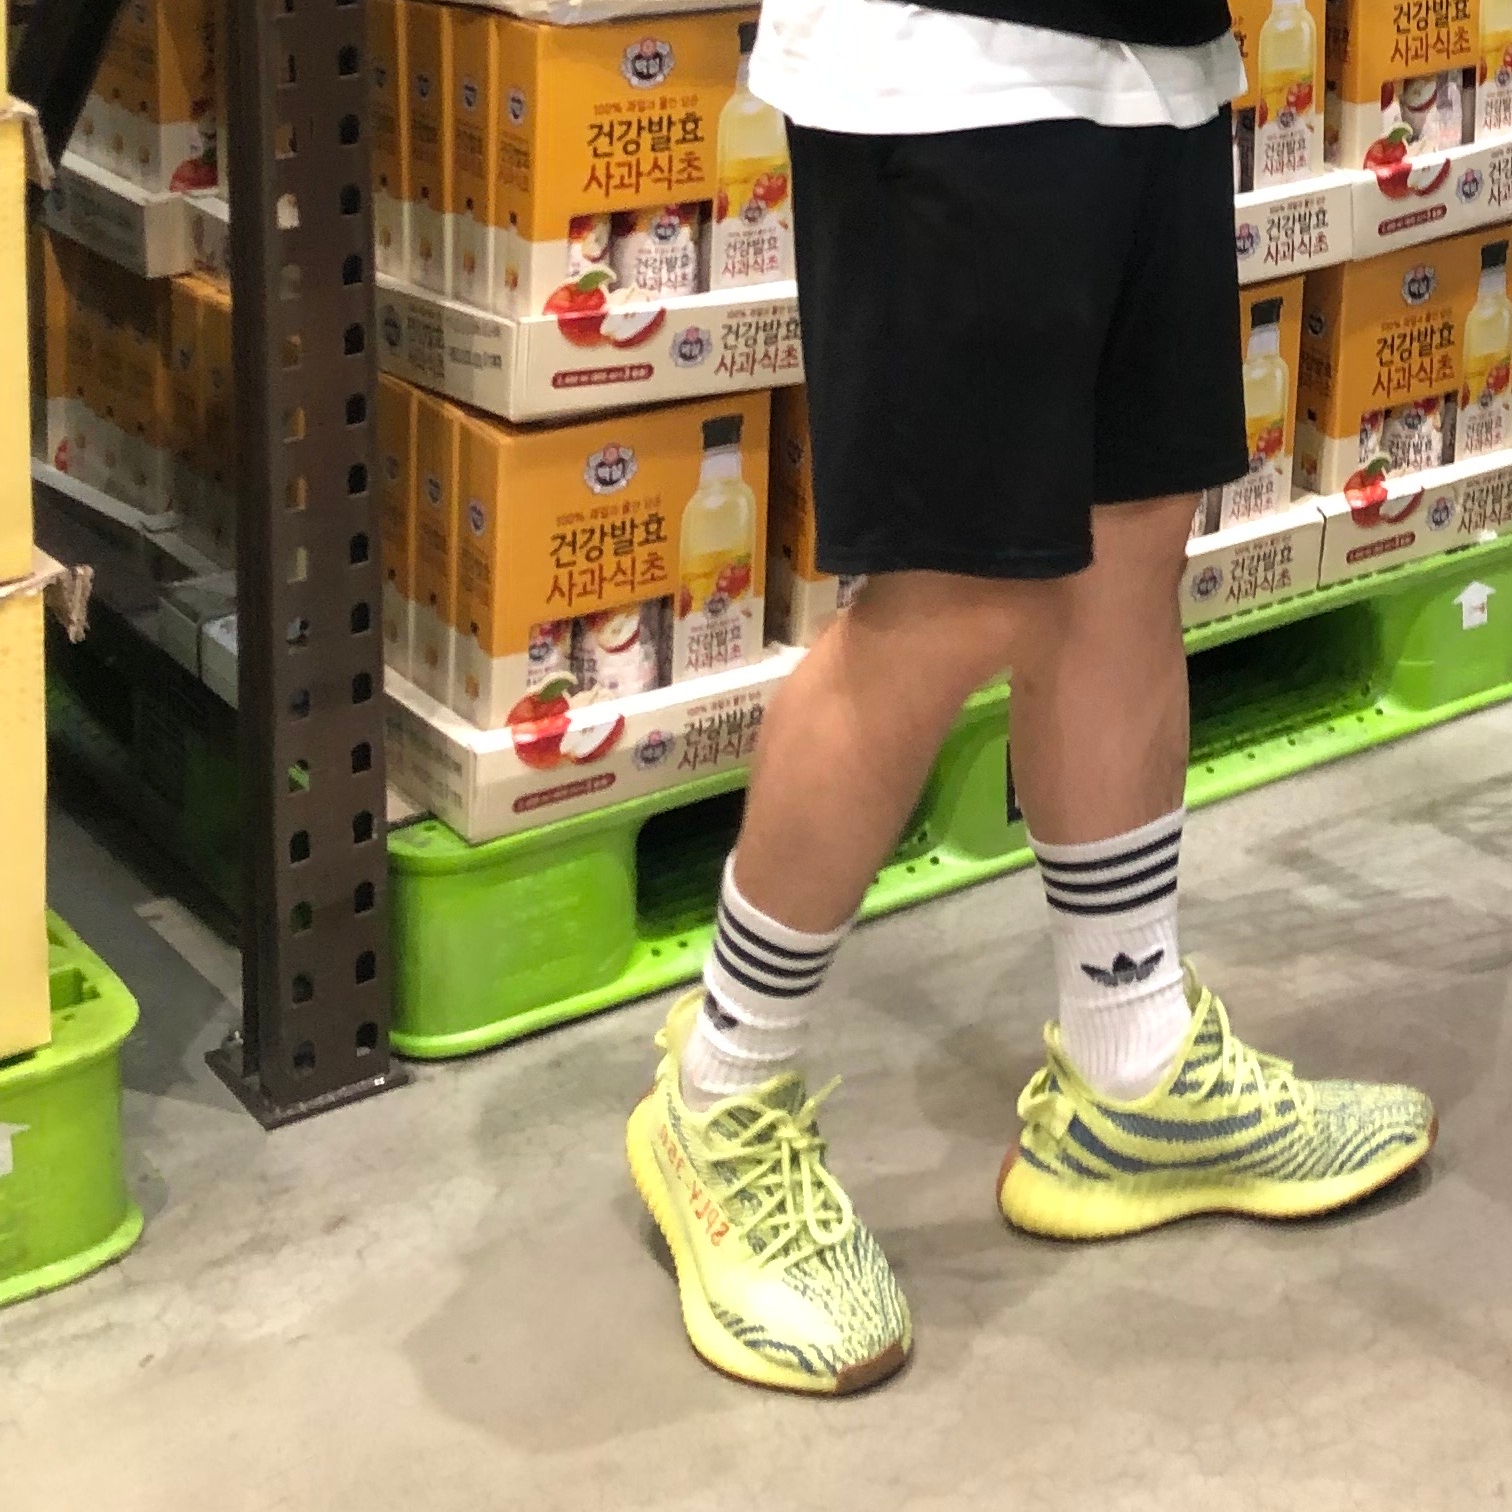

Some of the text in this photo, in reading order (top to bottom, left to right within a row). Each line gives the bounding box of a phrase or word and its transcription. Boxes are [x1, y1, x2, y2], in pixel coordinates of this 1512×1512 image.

[1390, 25, 1472, 67] 사과식초
[586, 111, 705, 159] 건강발효
[583, 152, 706, 197] 사과식초
[1265, 207, 1329, 246] 건강발효
[721, 254, 780, 277] 사과식초
[723, 236, 779, 259] 건강발효
[1263, 235, 1329, 267] 사과식초
[719, 314, 801, 352] 건강발효
[1376, 319, 1456, 368] 건강발효
[714, 343, 801, 378] 사과식초
[1371, 352, 1456, 400] 사과식초
[548, 513, 668, 569] 건강발효
[545, 552, 668, 608] 사과식초
[1230, 543, 1293, 584] 건강발효
[1224, 569, 1292, 605] 사과식초
[682, 705, 764, 743] 건강발효
